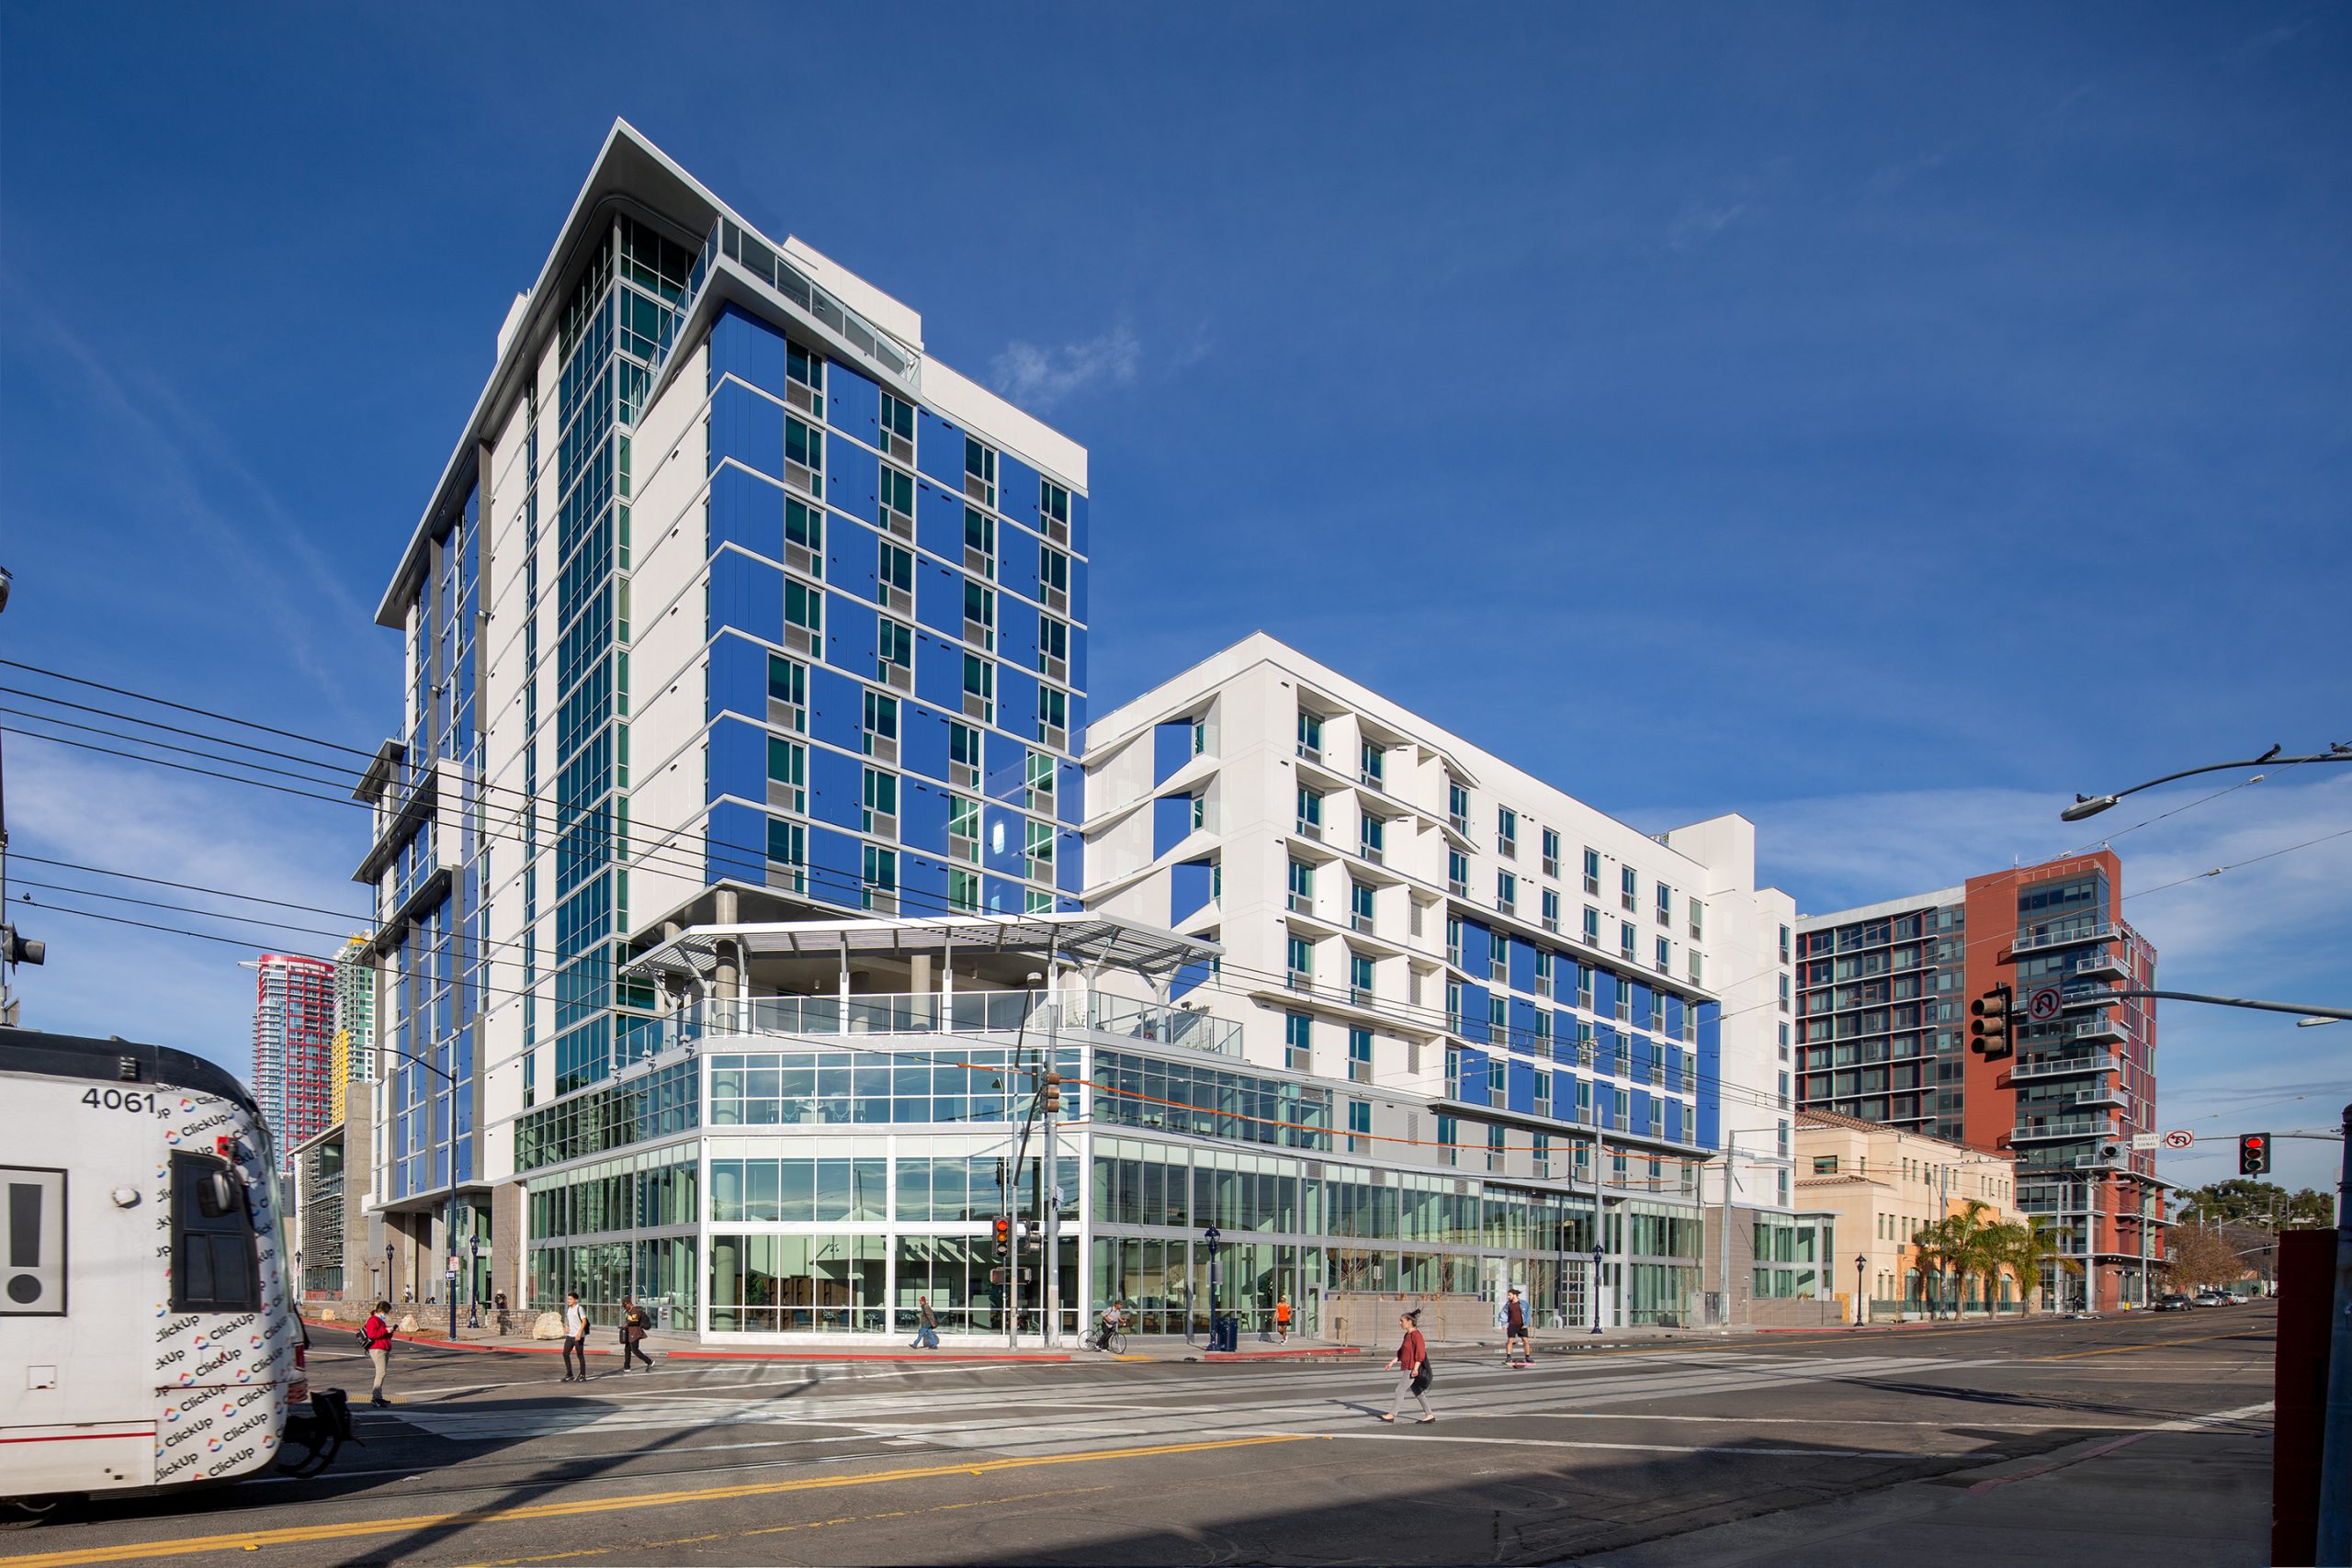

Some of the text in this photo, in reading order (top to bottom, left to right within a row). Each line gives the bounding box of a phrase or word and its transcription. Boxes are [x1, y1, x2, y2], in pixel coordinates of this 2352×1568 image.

[82, 1088, 154, 1113] 4061
[181, 1113, 228, 1137] ClickUp
[209, 1314, 255, 1340] ClickUp
[195, 1348, 243, 1377] ClickUp
[180, 1383, 228, 1412] ClickUp
[164, 1417, 213, 1448] ClickUp
[223, 1413, 268, 1442] ClickUp
[209, 1448, 255, 1477] ClickUp
